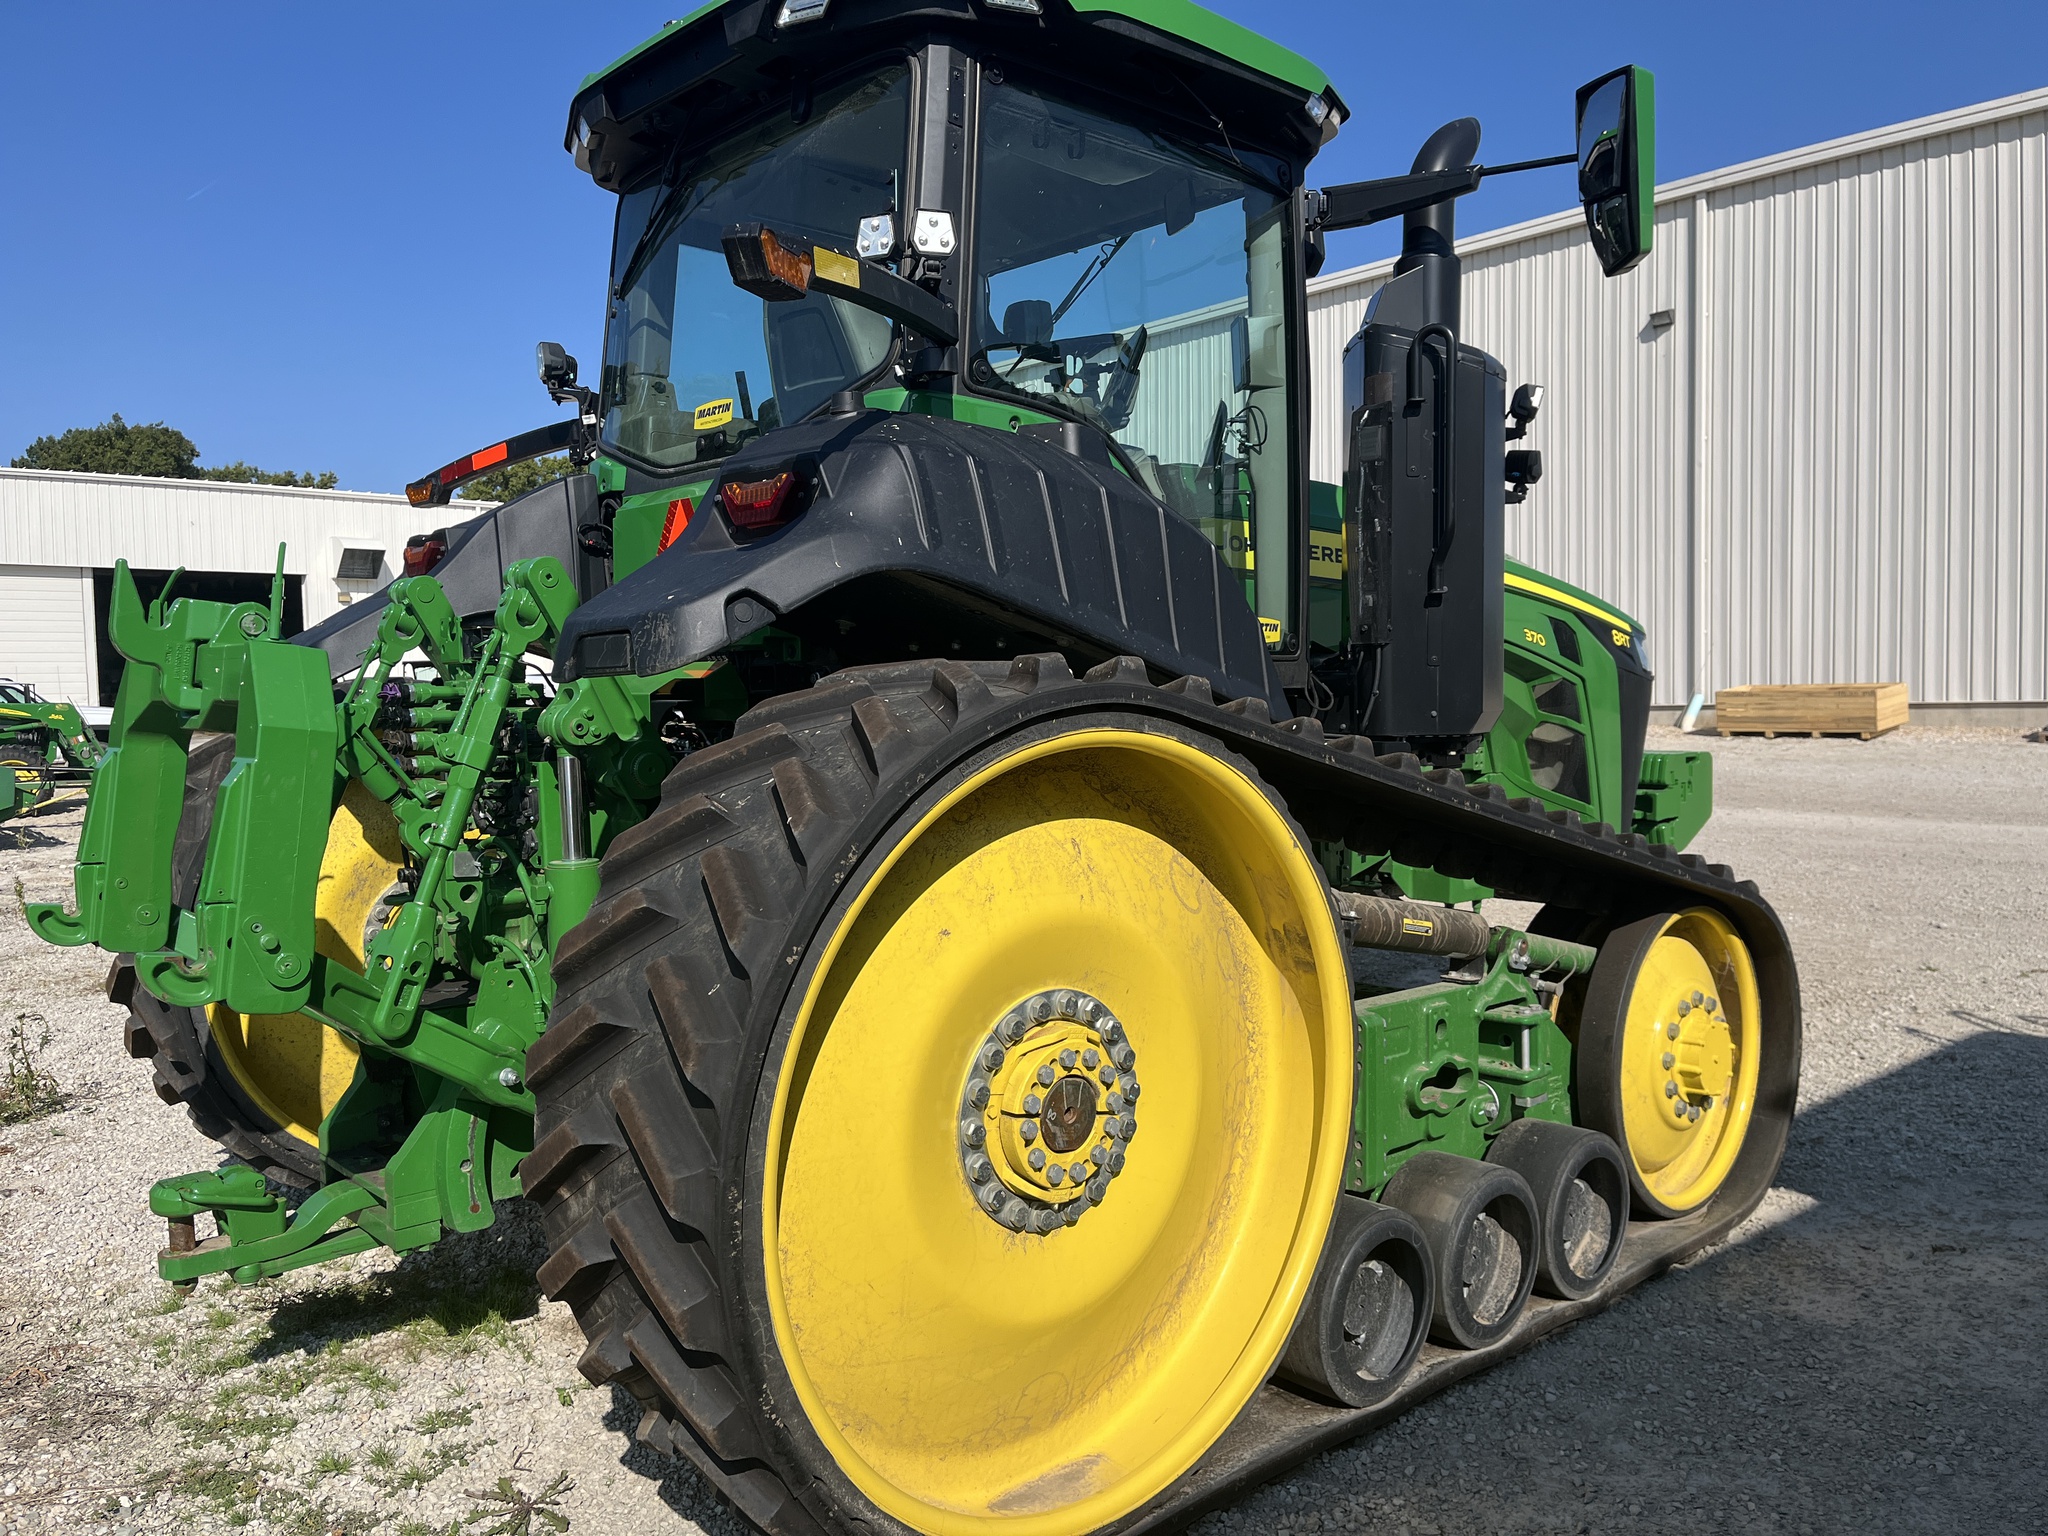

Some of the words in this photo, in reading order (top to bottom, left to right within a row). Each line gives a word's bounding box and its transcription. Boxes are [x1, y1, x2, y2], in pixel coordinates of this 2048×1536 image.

[696, 402, 731, 419] MARTIN
[1310, 545, 1342, 563] ERE
[1523, 628, 1546, 647] 370
[1611, 629, 1631, 648] 8RT
